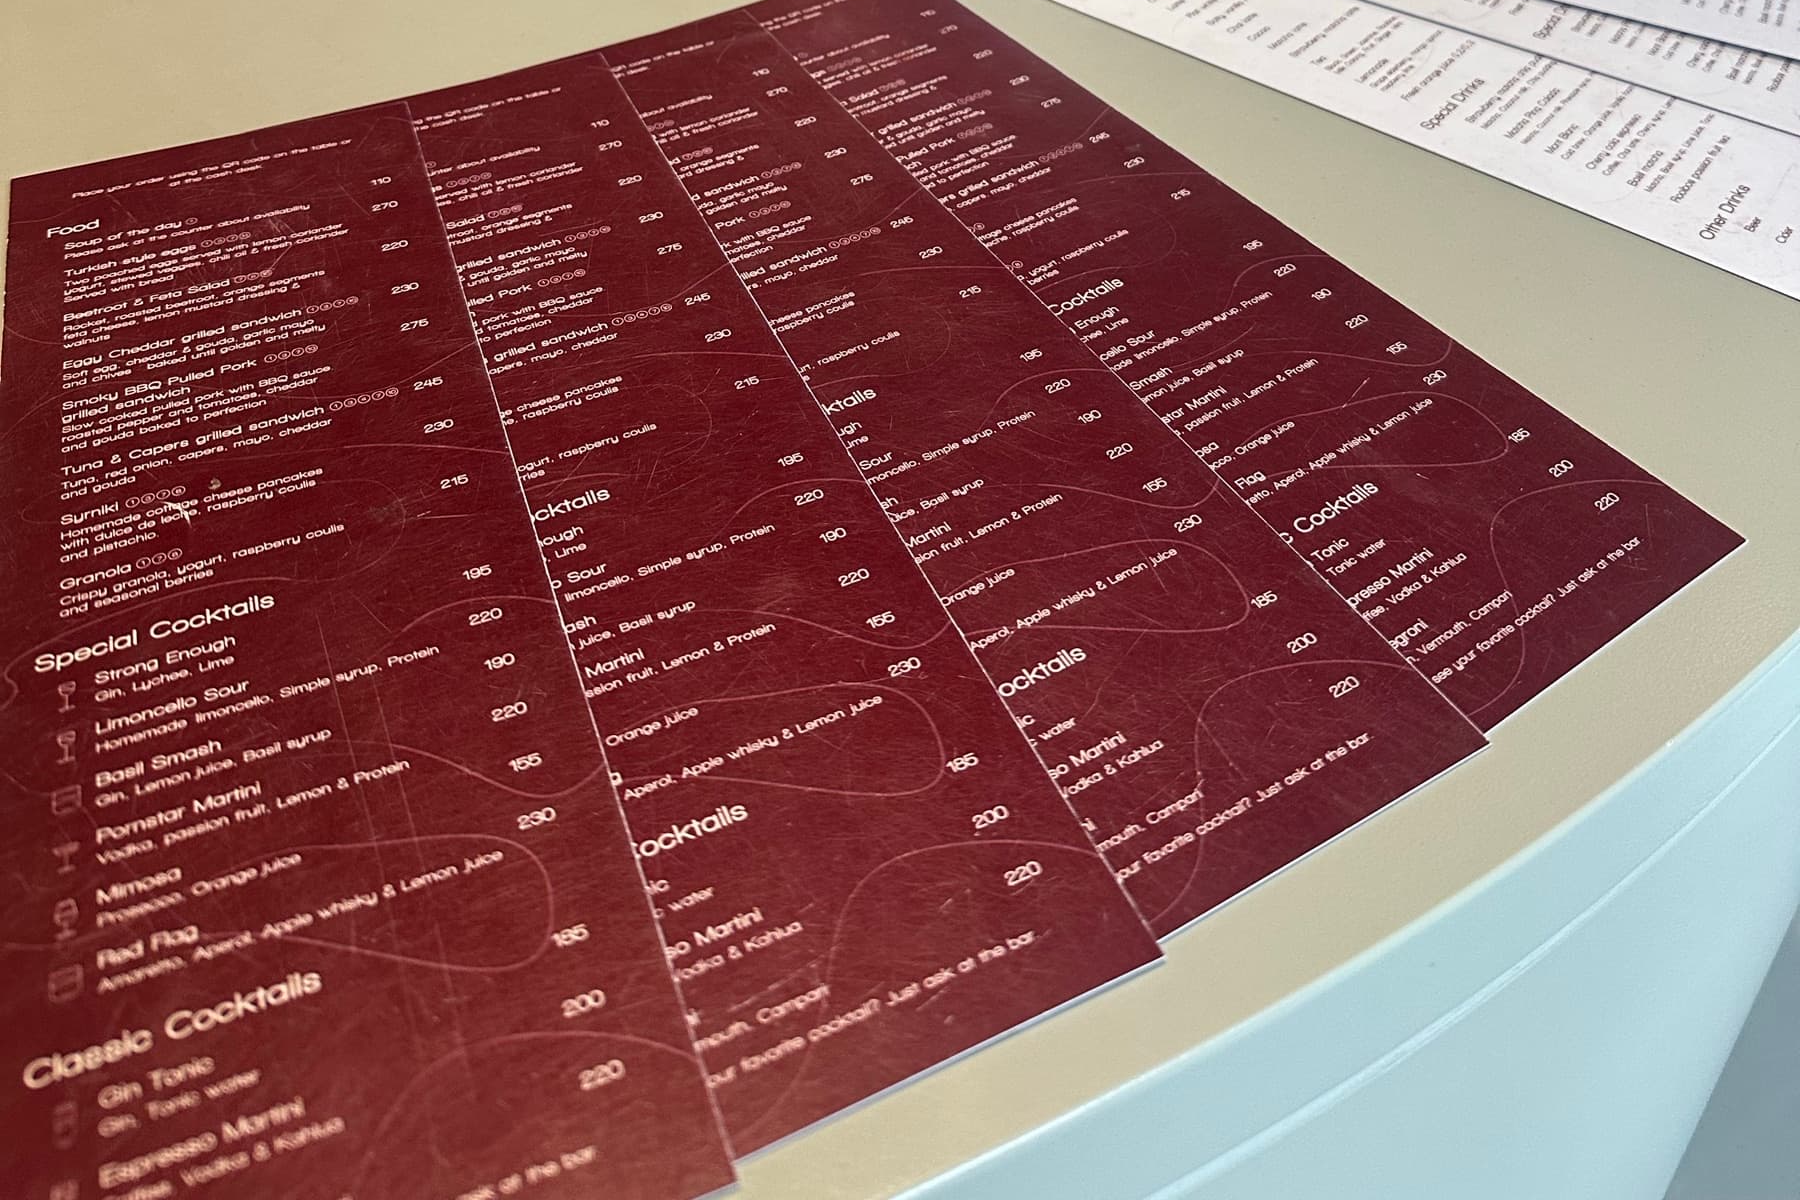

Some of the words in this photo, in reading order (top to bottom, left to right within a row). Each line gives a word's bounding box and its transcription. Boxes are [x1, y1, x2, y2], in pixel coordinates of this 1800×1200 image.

[1419, 100, 1459, 130] Special
[1450, 77, 1486, 103] Drinks
[1706, 144, 1723, 157] fruit
[370, 175, 392, 186] 110
[371, 199, 399, 212] 270
[1698, 212, 1728, 241] Other
[1717, 184, 1751, 214] Drinks
[46, 218, 100, 238] Food
[63, 237, 103, 250] Soup
[106, 231, 124, 241] of
[125, 227, 150, 237] the
[153, 220, 182, 232] day
[1742, 216, 1762, 233] Beer
[1774, 225, 1793, 244] Cider
[380, 239, 409, 252] 220
[63, 260, 117, 277] Turkish
[121, 252, 157, 265] style
[159, 244, 197, 257] eggs
[62, 301, 128, 322] Beetroot
[132, 297, 144, 307] &
[149, 290, 183, 303] Feta
[186, 277, 231, 294] Salad
[390, 281, 420, 295] 230
[683, 291, 711, 306] 245
[399, 317, 429, 332] 275
[1075, 305, 1120, 331] Enough
[62, 354, 103, 370] Eggy
[107, 337, 176, 359] Cheddar
[180, 325, 225, 344] grilled
[230, 309, 302, 331] sandwich
[493, 341, 536, 362] grilled
[540, 322, 609, 347] sandwich
[1019, 347, 1043, 362] 195
[61, 391, 119, 411] Smoky
[124, 380, 162, 396] BBQ
[167, 367, 215, 386] Pulled
[219, 358, 257, 374] Pork
[412, 375, 443, 391] 245
[733, 375, 760, 390] 215
[1044, 377, 1071, 394] 220
[61, 403, 109, 425] grilled
[114, 386, 191, 410] sandwich
[1077, 409, 1102, 424] 190
[423, 418, 454, 434] 230
[921, 441, 960, 461] Simple
[996, 410, 1036, 430] Protein
[1507, 427, 1531, 443] 185
[60, 459, 103, 476] Tuna
[109, 453, 122, 465] &
[128, 439, 189, 460] Capers
[194, 424, 242, 446] grilled
[248, 406, 325, 431] sandwich
[777, 451, 804, 467] 195
[1547, 459, 1574, 478] 200
[439, 473, 469, 490] 215
[1141, 476, 1168, 493] 155
[1233, 470, 1267, 490] Flag
[1292, 482, 1379, 533] Cocktails
[1593, 491, 1620, 511] 220
[60, 500, 119, 526] Syrniki
[1309, 537, 1350, 561] Tonic
[1325, 556, 1358, 577] Tonic
[1355, 538, 1386, 559] water
[461, 563, 492, 581] 195
[1387, 546, 1434, 579] Martini
[59, 563, 132, 590] Granola
[1430, 666, 1453, 684] see
[1451, 649, 1477, 671] your
[1475, 623, 1516, 653] favorite
[1513, 592, 1556, 627] cocktail?
[1556, 579, 1579, 598] Just
[1577, 566, 1599, 583] ask
[1595, 558, 1609, 570] at
[1605, 548, 1625, 562] the
[1468, 588, 1513, 621] Campari
[468, 607, 503, 626] 220
[865, 610, 896, 629] 155
[33, 628, 138, 673] Special
[149, 594, 275, 639] Cocktails
[1285, 631, 1318, 654] 200
[94, 658, 159, 684] Strong
[165, 635, 236, 665] Enough
[198, 655, 235, 673] Lime
[483, 652, 516, 671] 190
[583, 647, 645, 679] Martini
[887, 656, 921, 678] 230
[95, 696, 198, 735] Limoncello
[203, 680, 249, 702] Sour
[490, 700, 528, 722] 220
[604, 720, 662, 747] Orange
[663, 707, 699, 729] juice
[680, 756, 724, 779] Apple
[725, 735, 780, 760] whisky
[781, 727, 794, 740] &
[794, 709, 846, 734] Lemon
[848, 695, 883, 717] juice
[1068, 730, 1127, 767] Martini
[94, 760, 145, 788] Basil
[150, 739, 222, 771] Smash
[508, 751, 542, 772] 155
[945, 751, 979, 773] 185
[95, 806, 186, 844] Pornstar
[192, 780, 262, 814] Martini
[516, 806, 556, 830] 230
[95, 867, 182, 905] Mimosa
[96, 939, 145, 969] Red
[150, 924, 199, 951] Flag
[22, 1028, 153, 1090] Classic
[163, 971, 323, 1041] Cocktails
